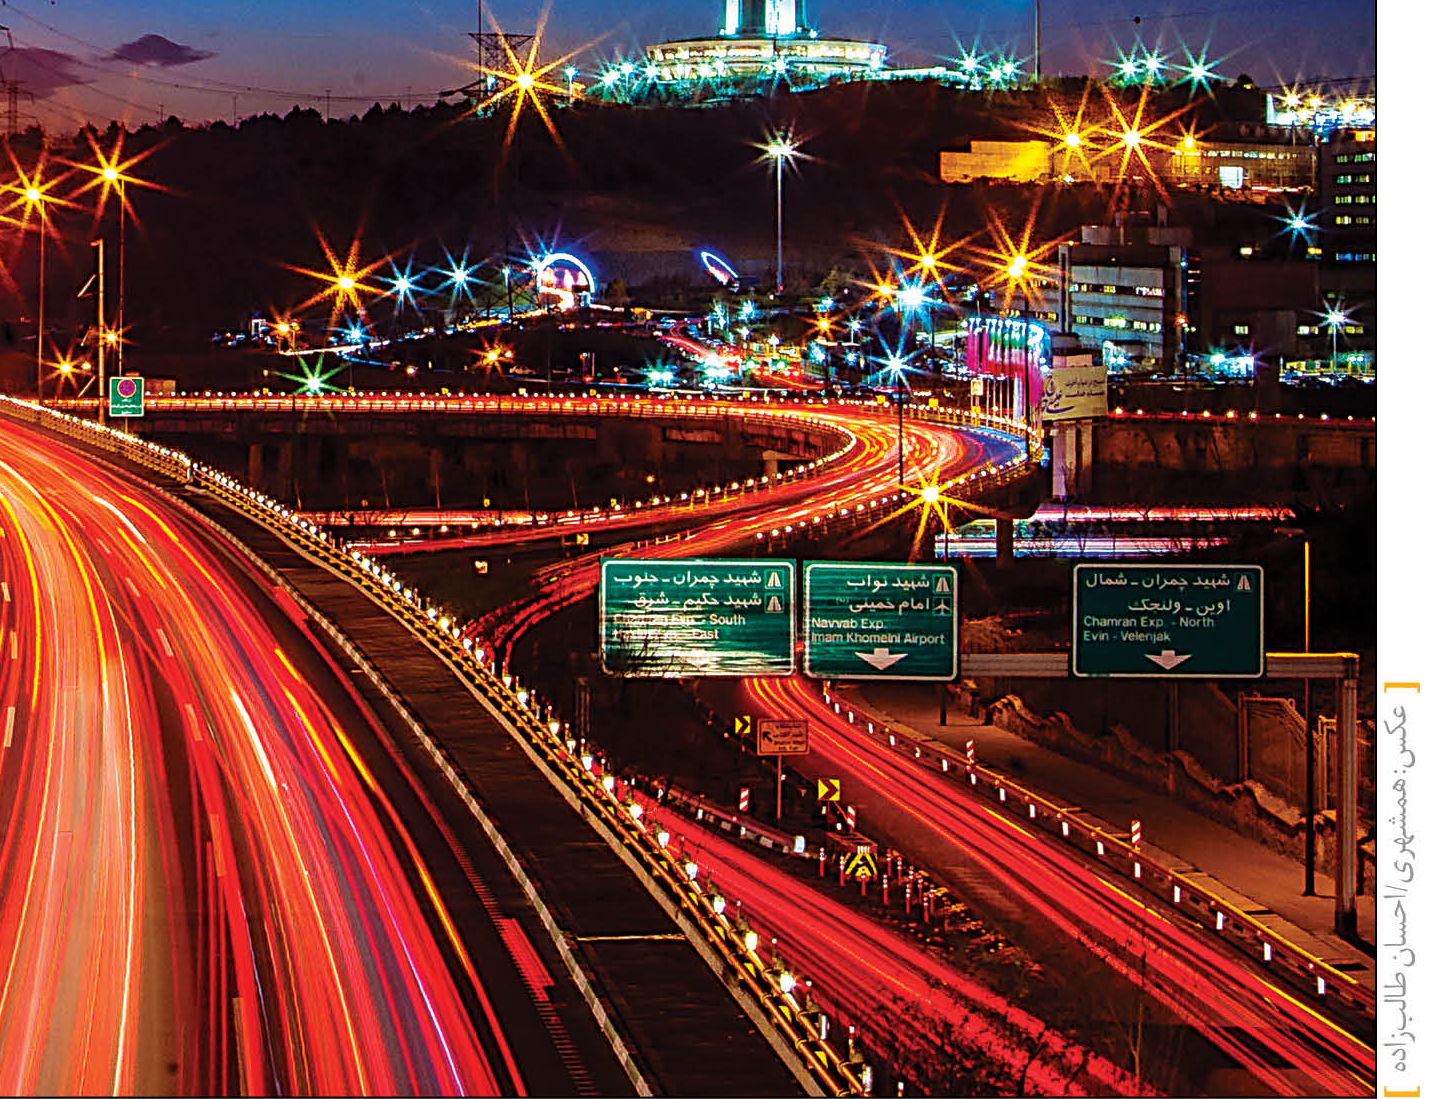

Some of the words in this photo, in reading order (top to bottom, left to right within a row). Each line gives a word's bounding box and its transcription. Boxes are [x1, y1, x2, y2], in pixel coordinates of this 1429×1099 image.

[614, 571, 659, 589] جنوب
[673, 570, 720, 590] چمران
[723, 570, 762, 586] شهید
[847, 574, 888, 593] نواب
[892, 573, 930, 591] شهید
[1085, 572, 1128, 588] شمال
[1142, 573, 1188, 593] چمران
[1192, 573, 1231, 590] شهید
[683, 592, 720, 611] حکیم
[723, 592, 762, 608] شهید
[848, 597, 895, 612] خمینی
[898, 597, 930, 615] امام
[1128, 598, 1181, 614] ولنجک
[1196, 599, 1231, 616] اوین
[709, 613, 746, 626] South
[1083, 615, 1137, 628] Chamran
[1179, 616, 1215, 627] North
[812, 632, 843, 643] Imam
[846, 632, 901, 644] Khomeini
[904, 633, 945, 646] Airport
[1083, 630, 1109, 642] Evin
[1120, 630, 1171, 644] Velenjak
